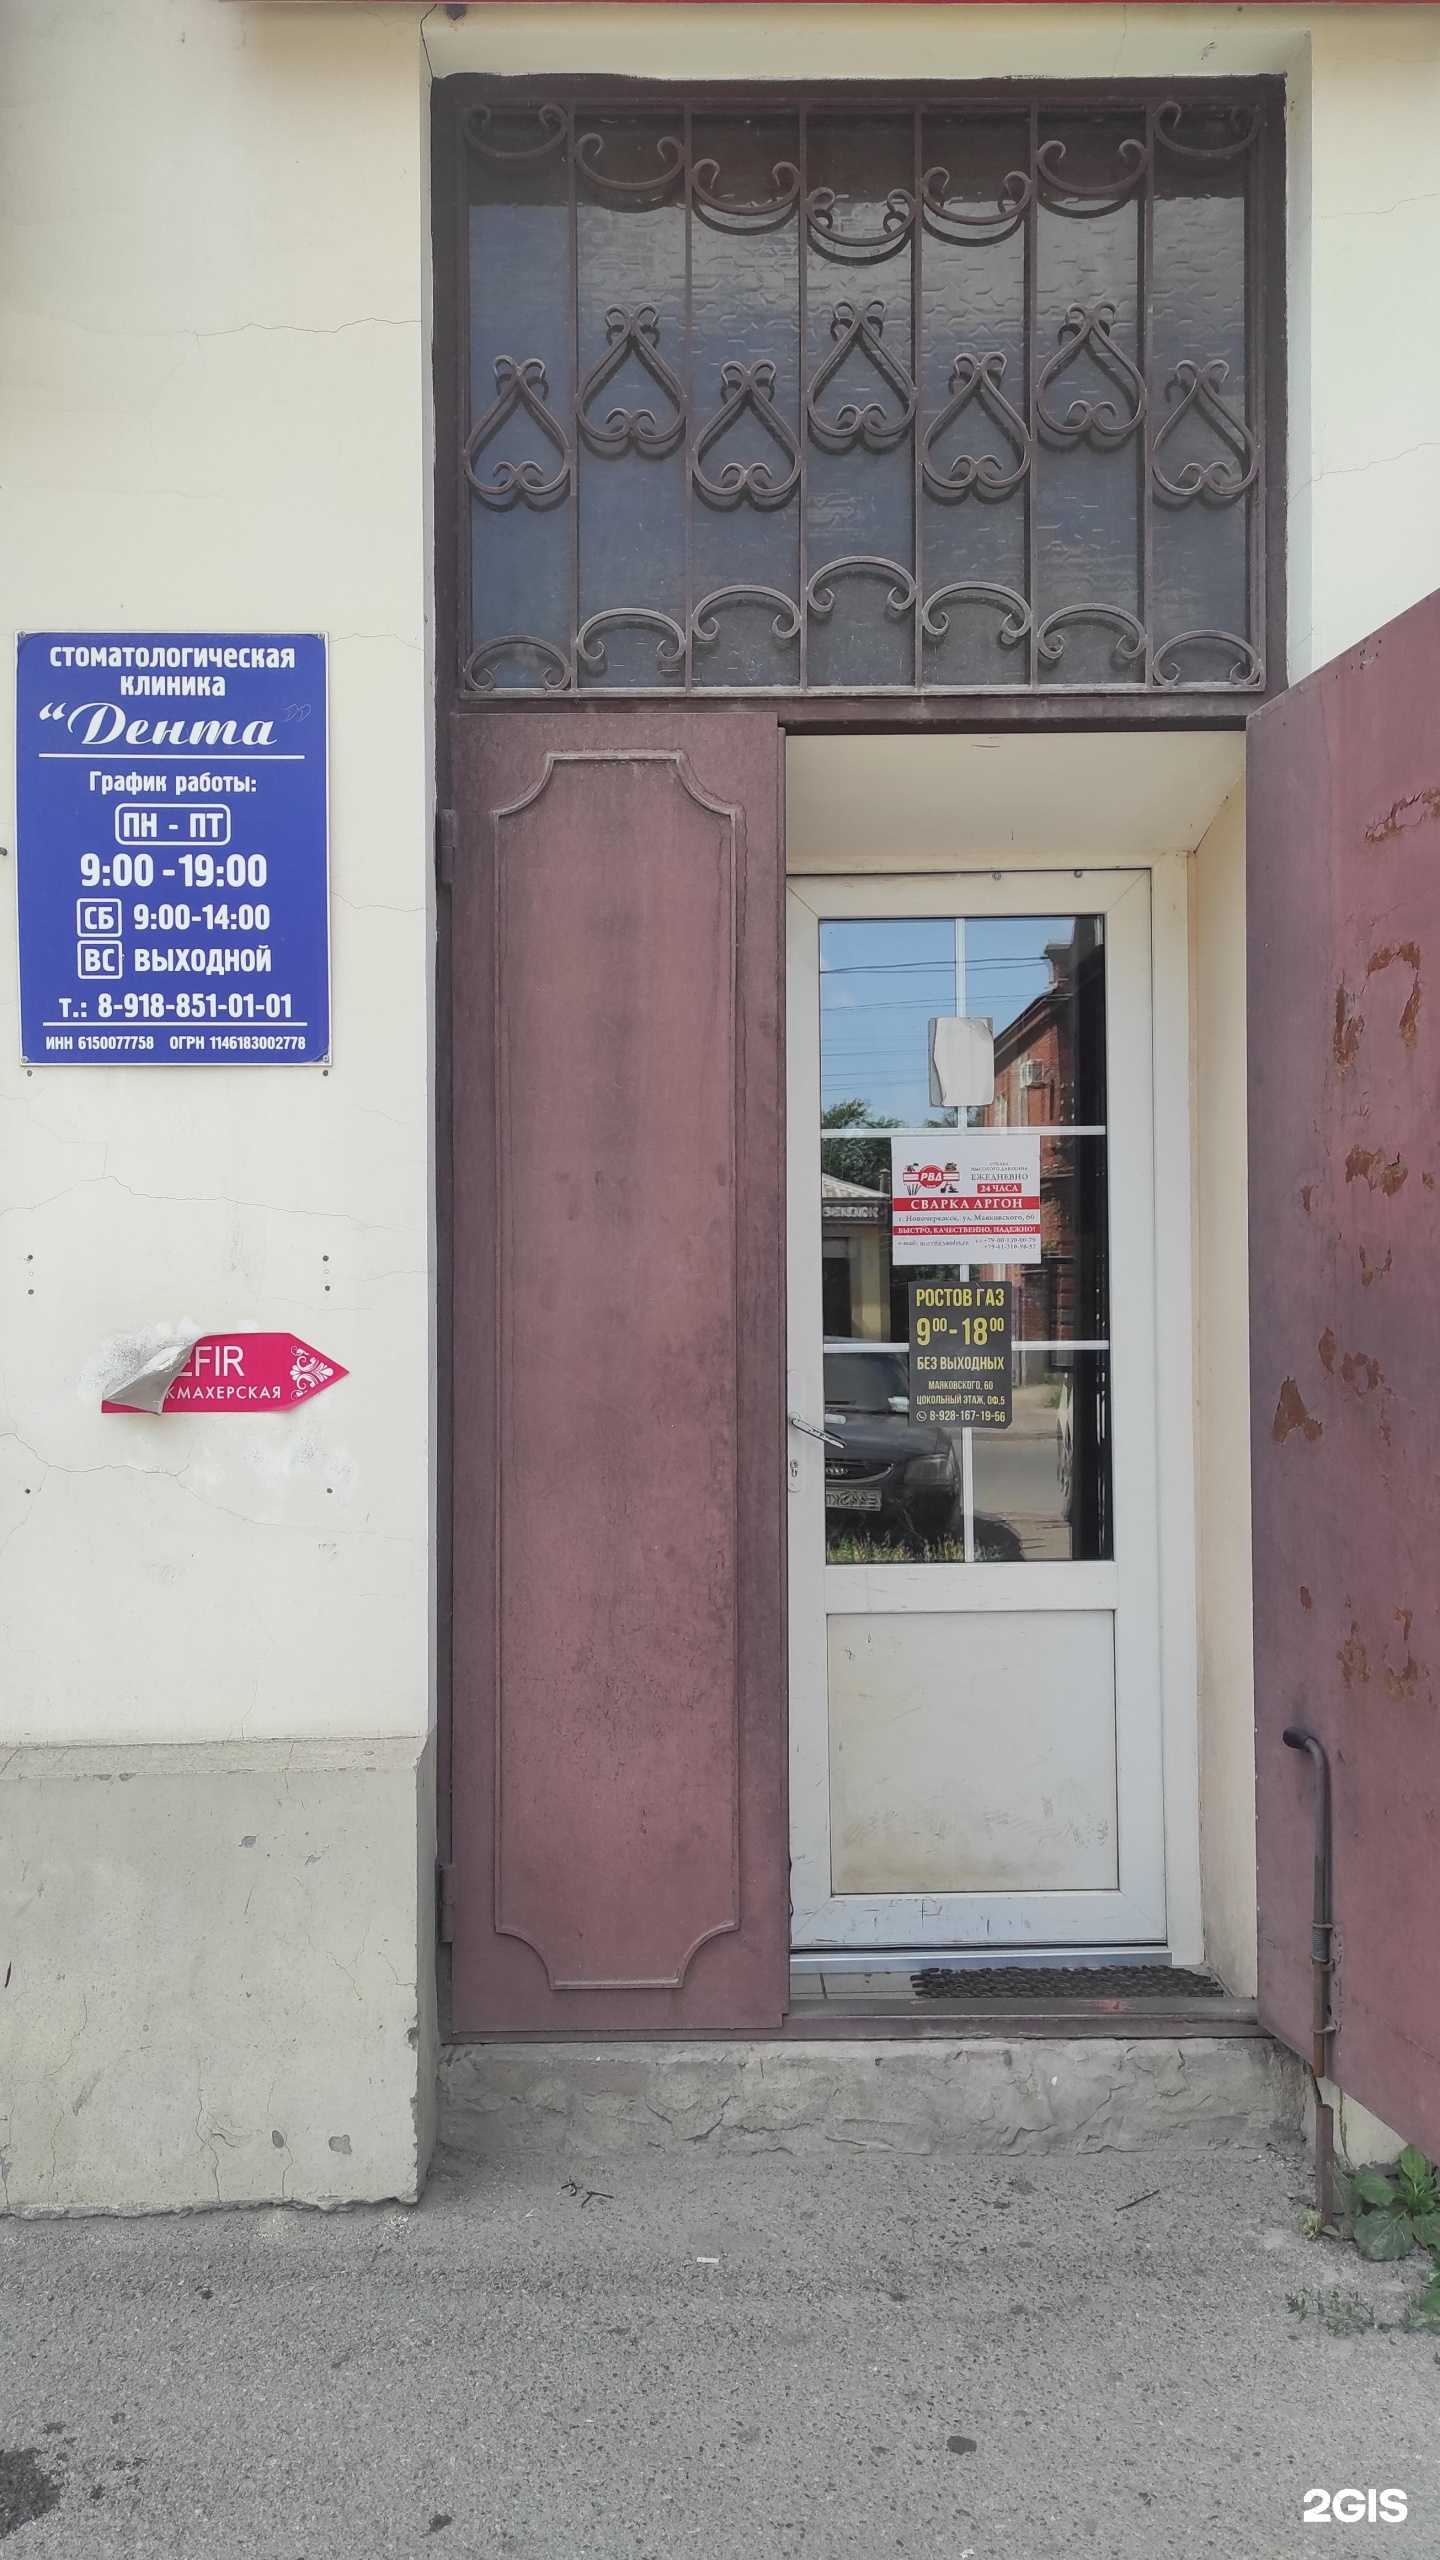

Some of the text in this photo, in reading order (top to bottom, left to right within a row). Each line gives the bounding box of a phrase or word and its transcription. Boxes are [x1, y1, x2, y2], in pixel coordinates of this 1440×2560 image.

[89, 771, 257, 795] График работы:
[122, 812, 158, 838] ПН
[189, 812, 224, 838] ПТ
[80, 853, 154, 888] 9:00
[84, 904, 271, 930] СБ 9:00-14:00
[84, 943, 272, 975] ВС ВЫХОДНОЙ
[97, 993, 293, 1018] 8-918-851-01-01
[45, 1036, 306, 1050] ИНН 6150077758 ОГРН 1146183002778
[971, 1173, 1029, 1181] ЕЖЕДНЕВНО
[980, 1184, 1019, 1193] 24 ЧАСА
[911, 1198, 1023, 1210] СВАРКА АРГОН
[916, 1288, 1005, 1307] РОСТОВ ГАЗ
[917, 1357, 1005, 1371] БЕЗ ВЫХОДНЫХ
[928, 1380, 994, 1391] МАЯКОВСКОГО, 60
[916, 1393, 962, 1405] ЦОКОЛЬНЫЙ
[963, 1395, 986, 1405] ЭТАЖ,
